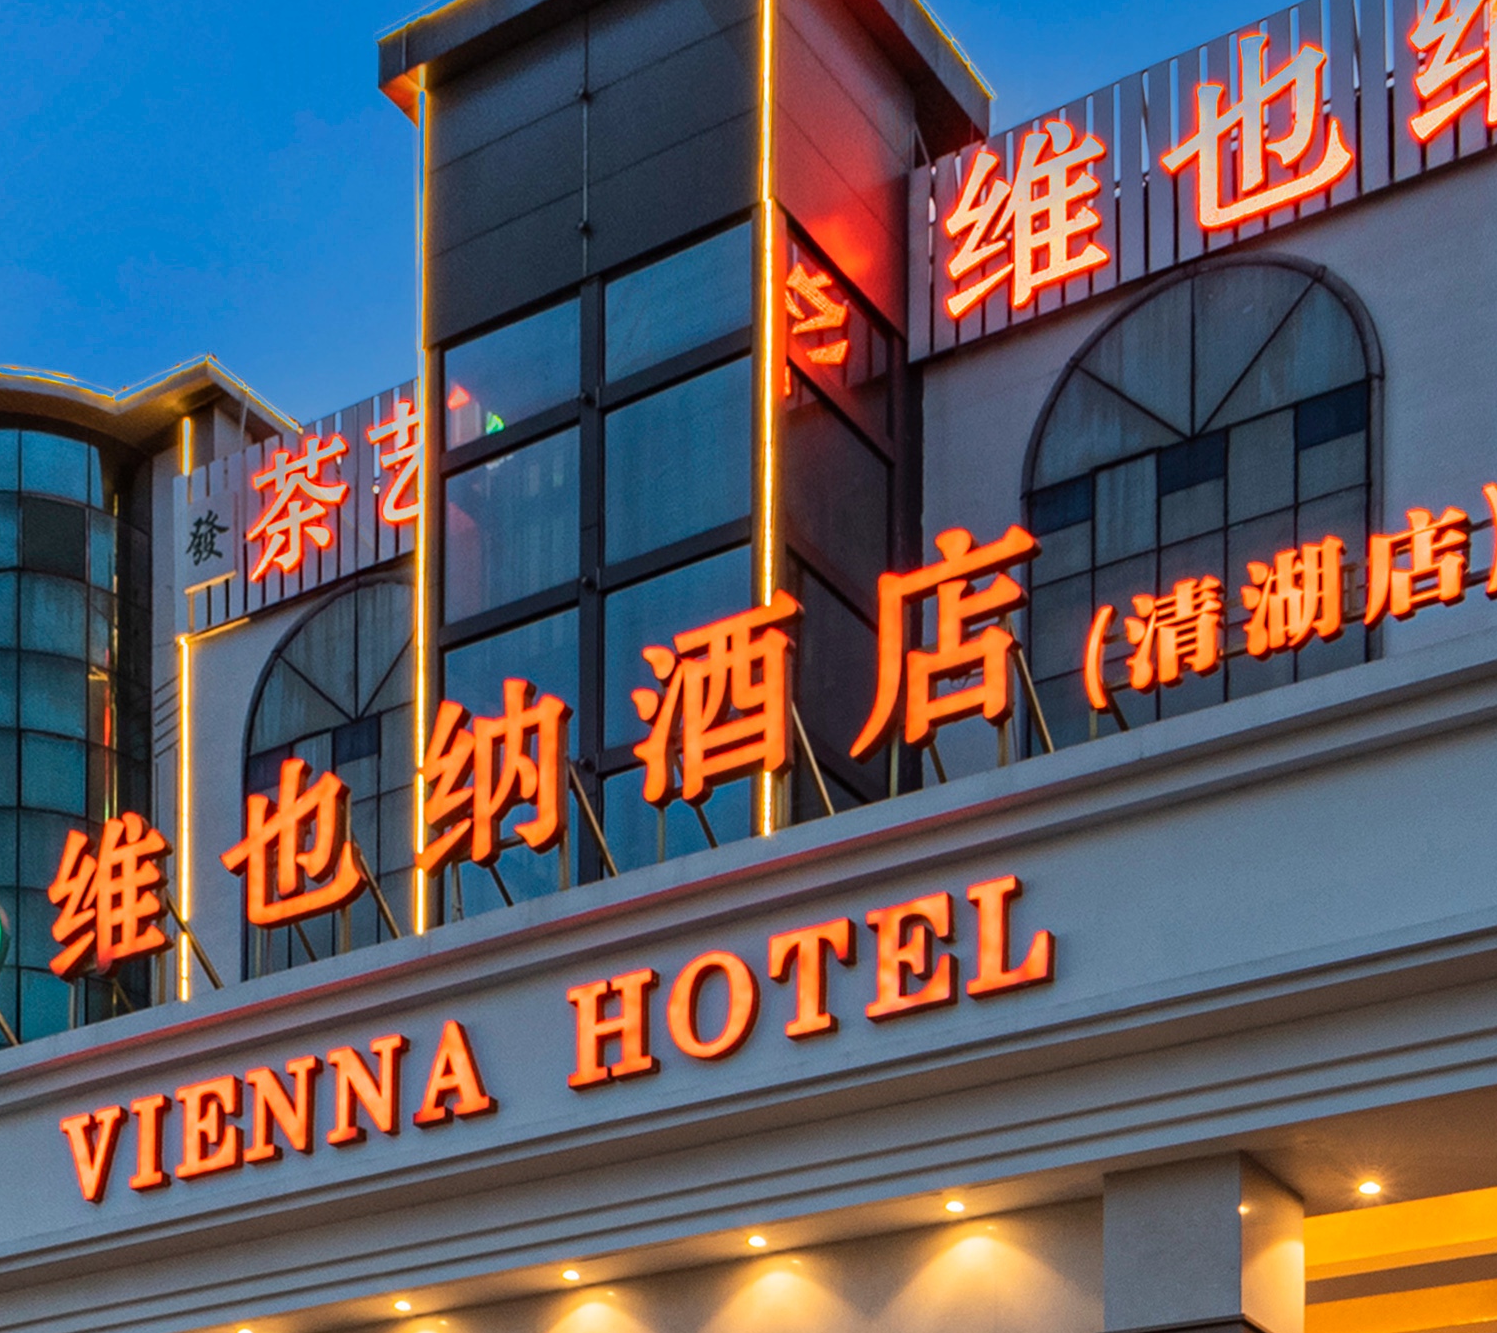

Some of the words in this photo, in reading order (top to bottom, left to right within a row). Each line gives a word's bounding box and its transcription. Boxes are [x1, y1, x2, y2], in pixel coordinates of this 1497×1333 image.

[47, 524, 1040, 980] 维也纳酒店
[60, 1019, 498, 1203] VIENNA
[568, 874, 1055, 1091] HOTEL
